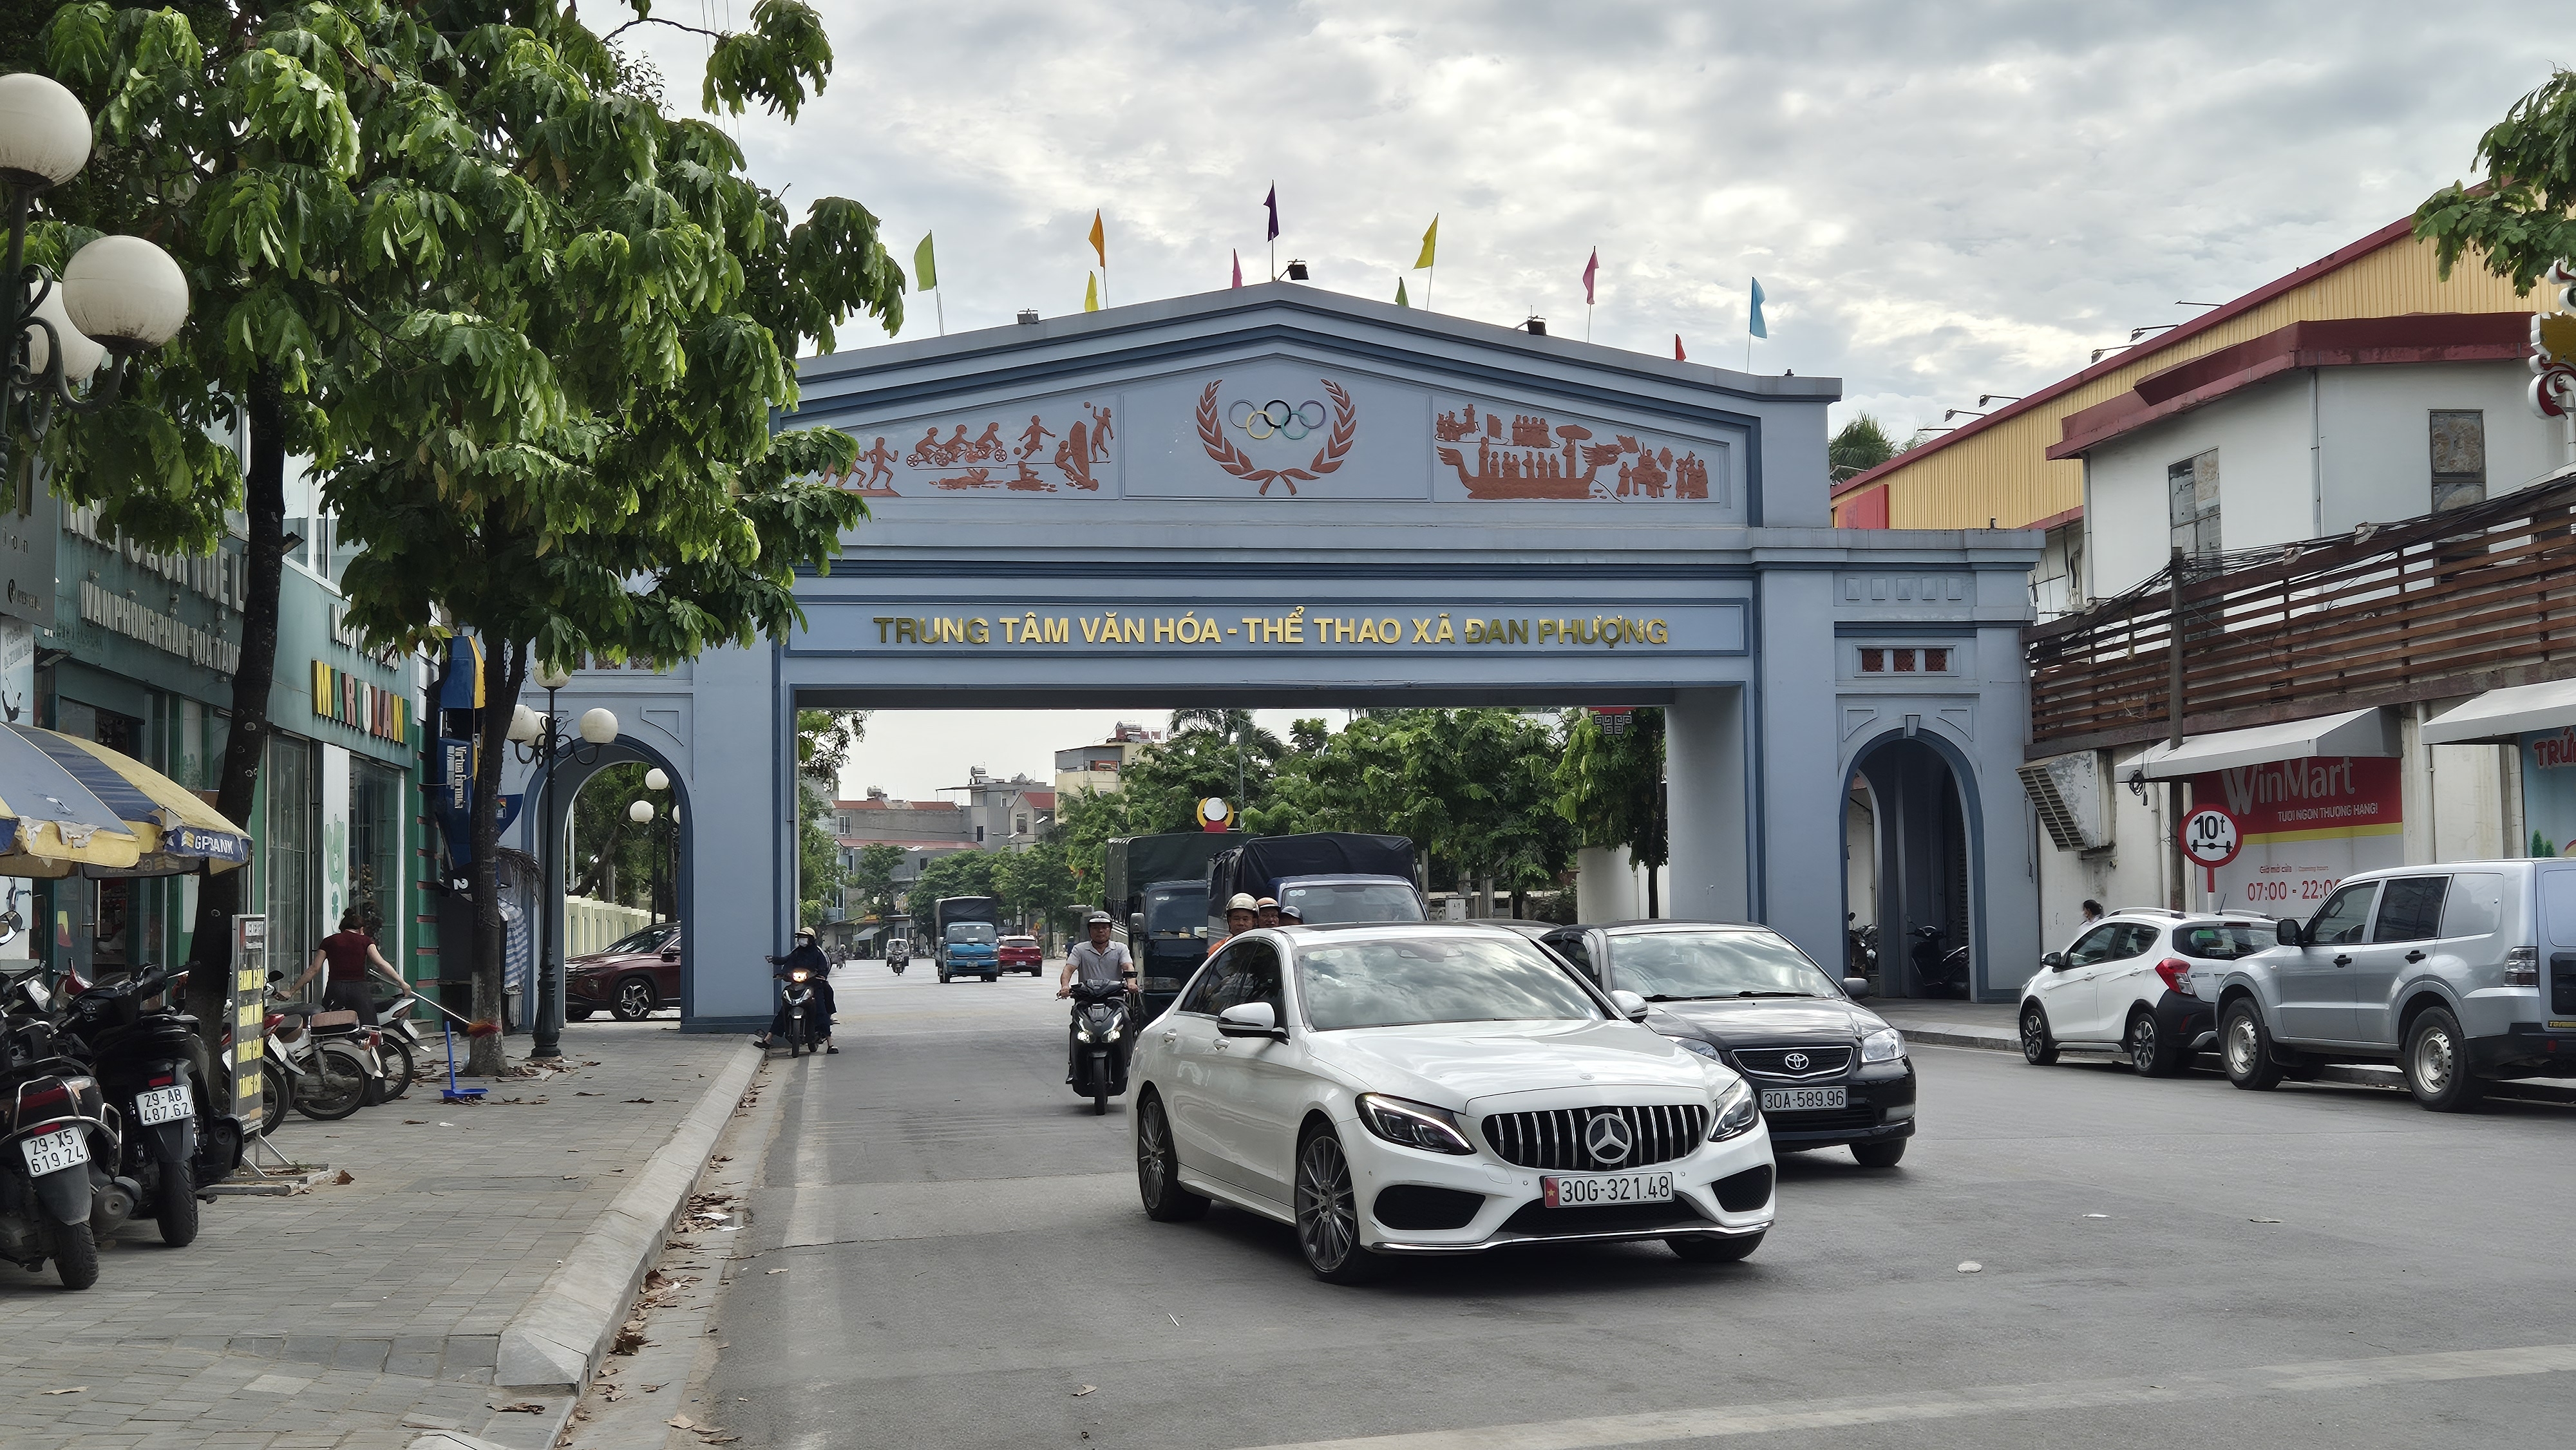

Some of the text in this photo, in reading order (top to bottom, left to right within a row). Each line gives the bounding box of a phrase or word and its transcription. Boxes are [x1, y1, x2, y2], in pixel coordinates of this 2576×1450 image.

[873, 617, 989, 643] TRUNG
[999, 612, 1068, 643] TÂM
[1079, 612, 1144, 643] VĂN
[1154, 611, 1221, 643] HÓA
[1242, 606, 1304, 643] THỂ
[1313, 618, 1402, 643] THAO
[1412, 613, 1455, 643] XÃ
[1464, 618, 1528, 643] ĐAN
[1537, 615, 1668, 648] PHƯỢNG
[2533, 726, 2576, 766] TRỨ
[2222, 757, 2355, 816] WinMart
[453, 878, 469, 890] 2
[2248, 881, 2287, 901] 07:00
[144, 1088, 182, 1107] 29-AB
[1765, 1091, 1844, 1109] 30A-589.96
[144, 1102, 191, 1122] 487.62
[30, 1129, 74, 1156] 29-X5
[31, 1145, 84, 1173] 619.24
[1562, 1176, 1669, 1202] 30G-321.48
